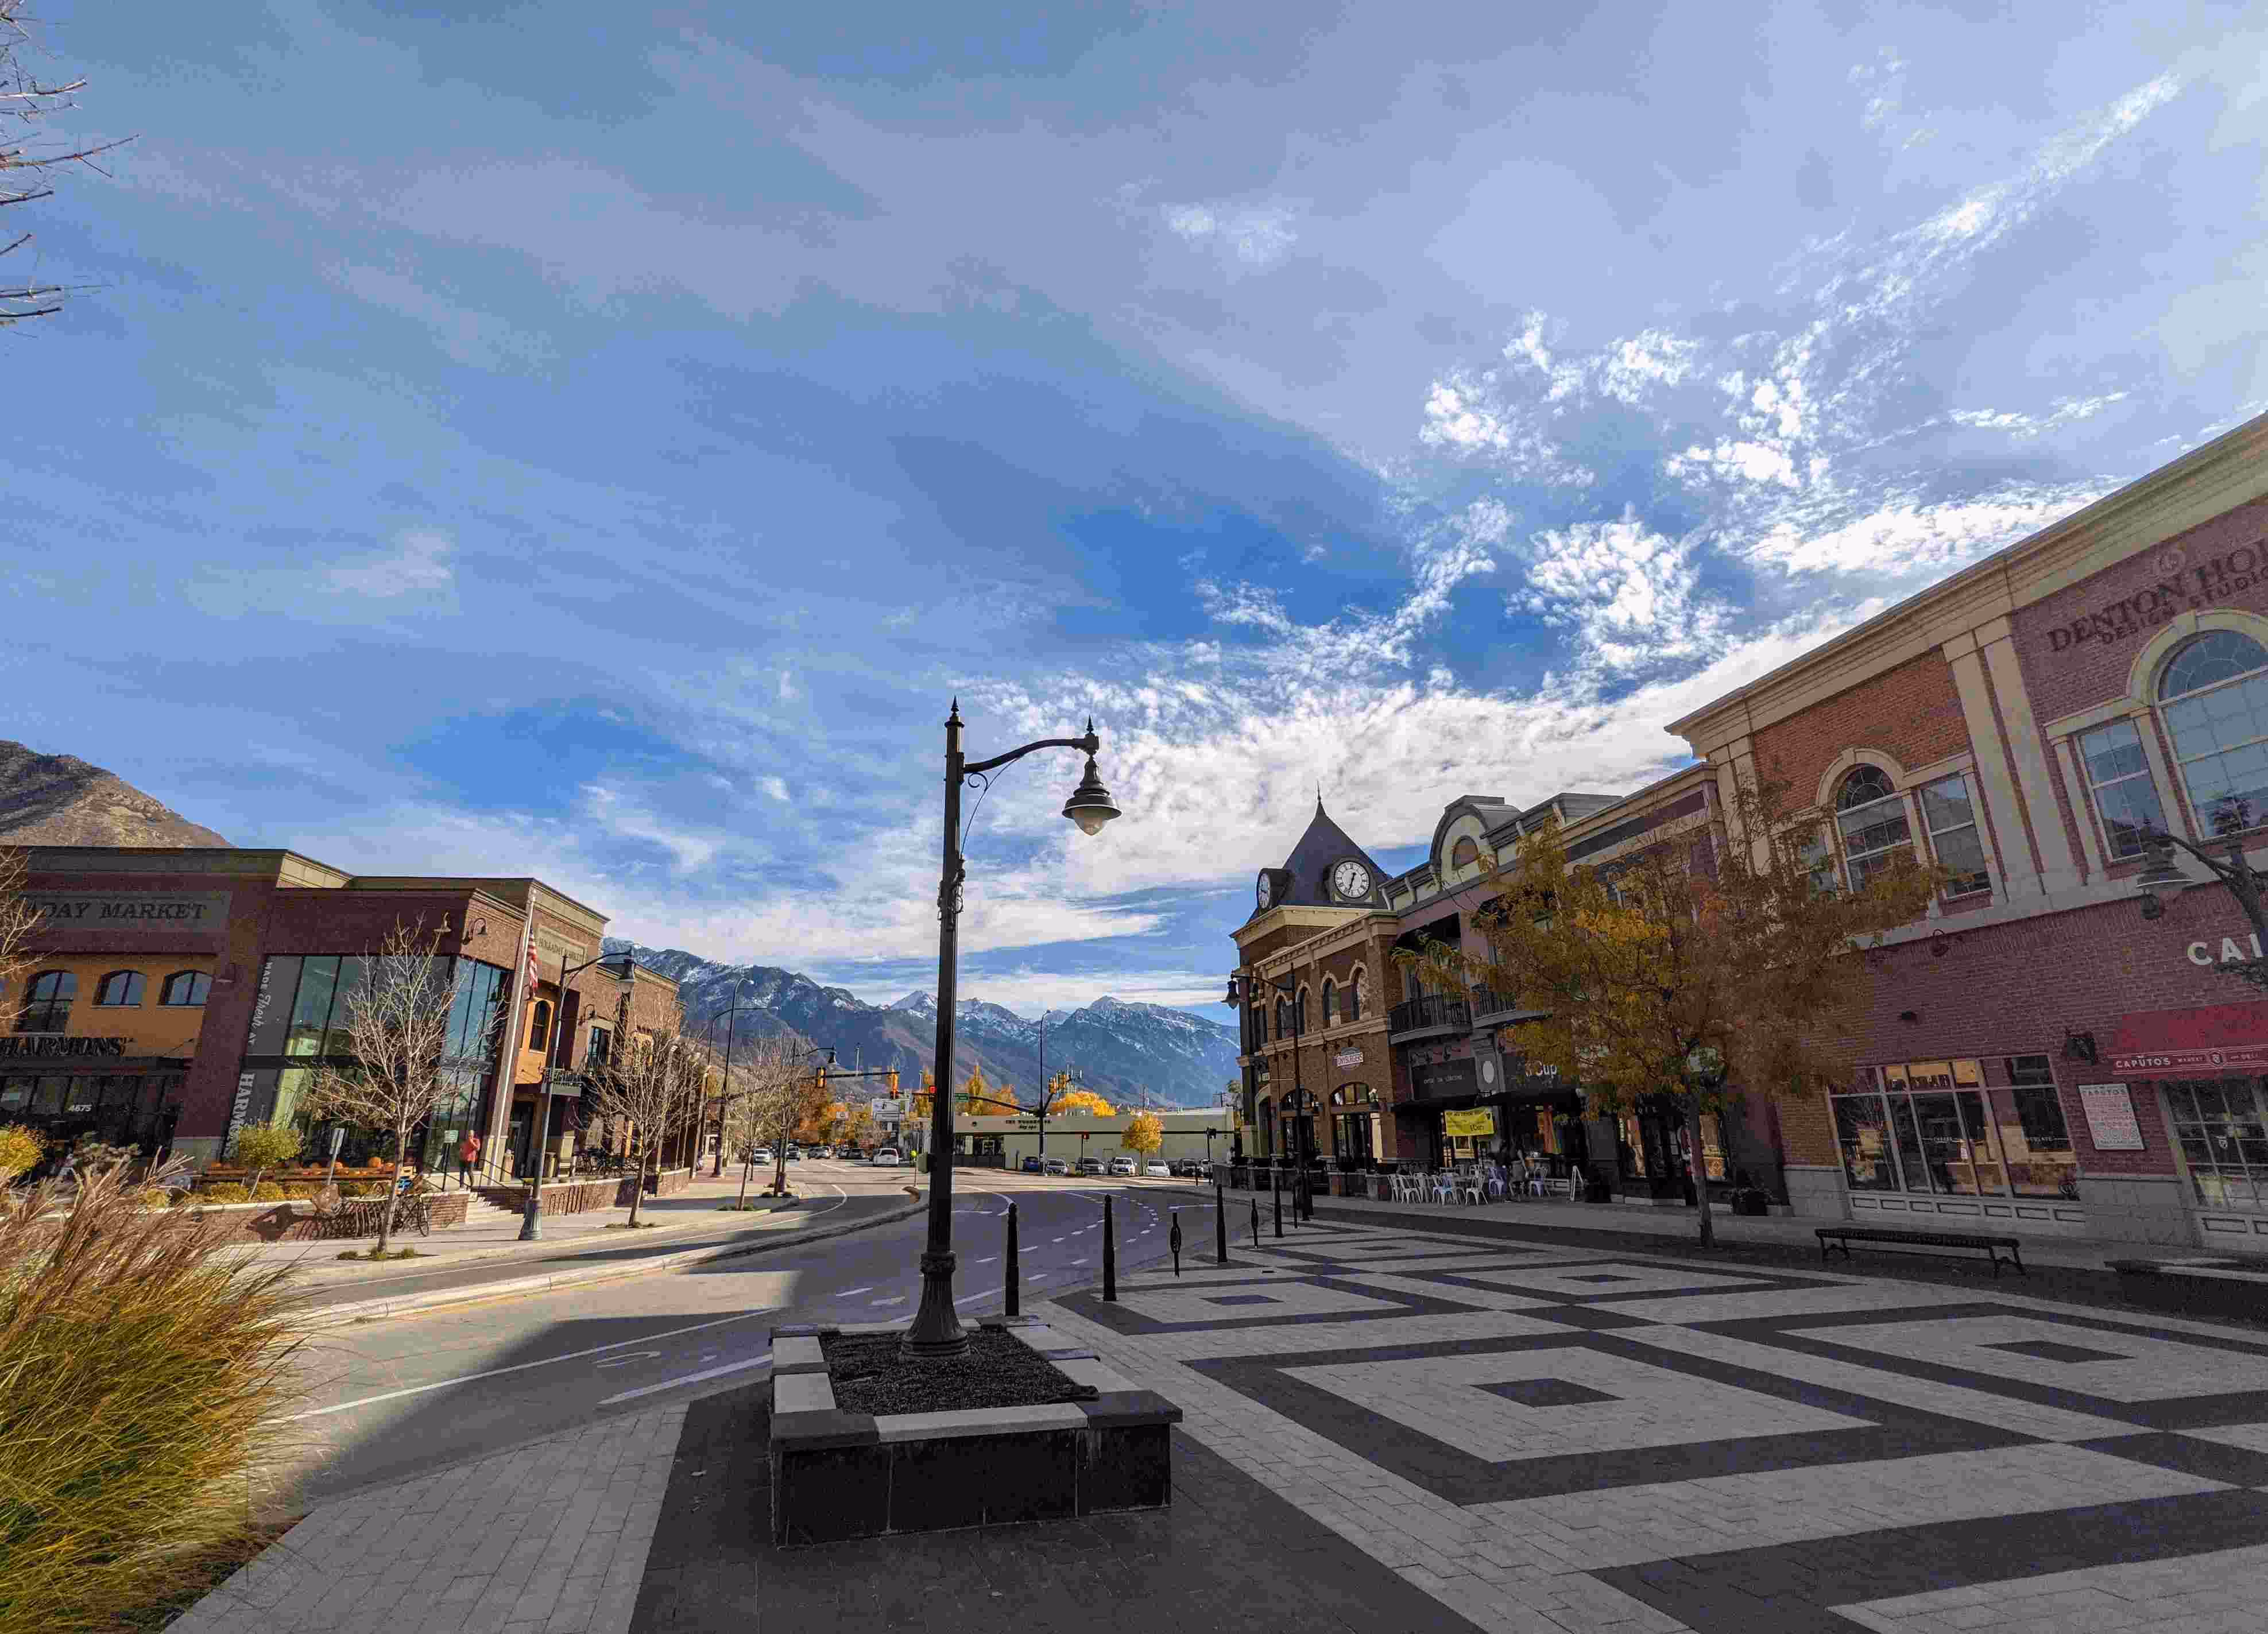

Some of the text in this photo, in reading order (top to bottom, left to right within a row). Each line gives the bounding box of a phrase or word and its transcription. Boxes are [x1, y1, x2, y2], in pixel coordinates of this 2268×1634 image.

[2047, 573, 2185, 652] DENTON
[98, 903, 207, 919] MARKET
[260, 961, 273, 990] MADE
